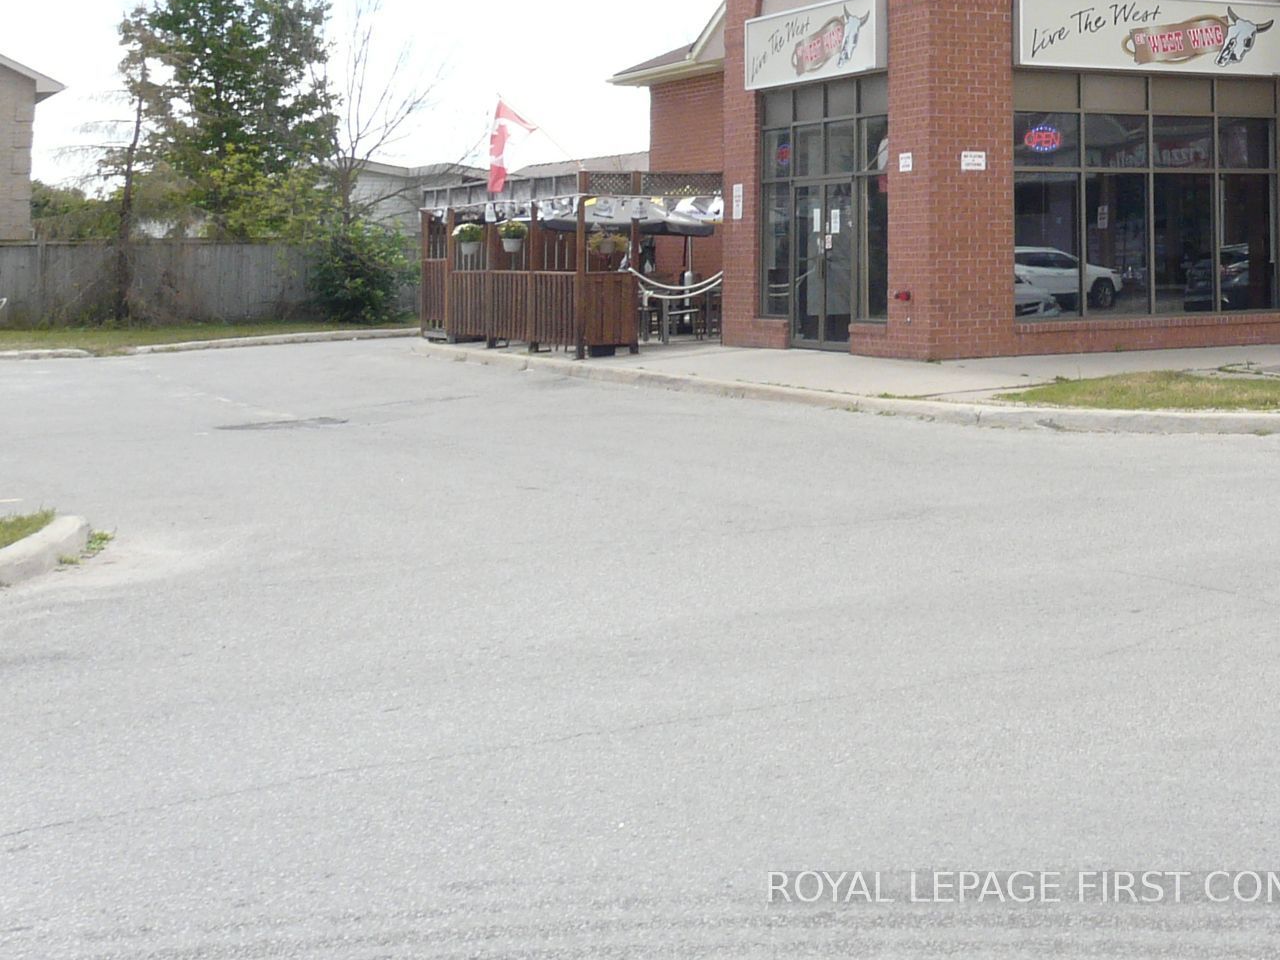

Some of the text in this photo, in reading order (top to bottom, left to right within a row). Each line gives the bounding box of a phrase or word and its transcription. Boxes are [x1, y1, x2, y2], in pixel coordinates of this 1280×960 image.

[751, 16, 810, 82] Live The West
[1031, 1, 1162, 58] Live The West
[1147, 31, 1185, 54] WEST
[1188, 24, 1224, 49] WING
[1024, 131, 1061, 148] OPEN
